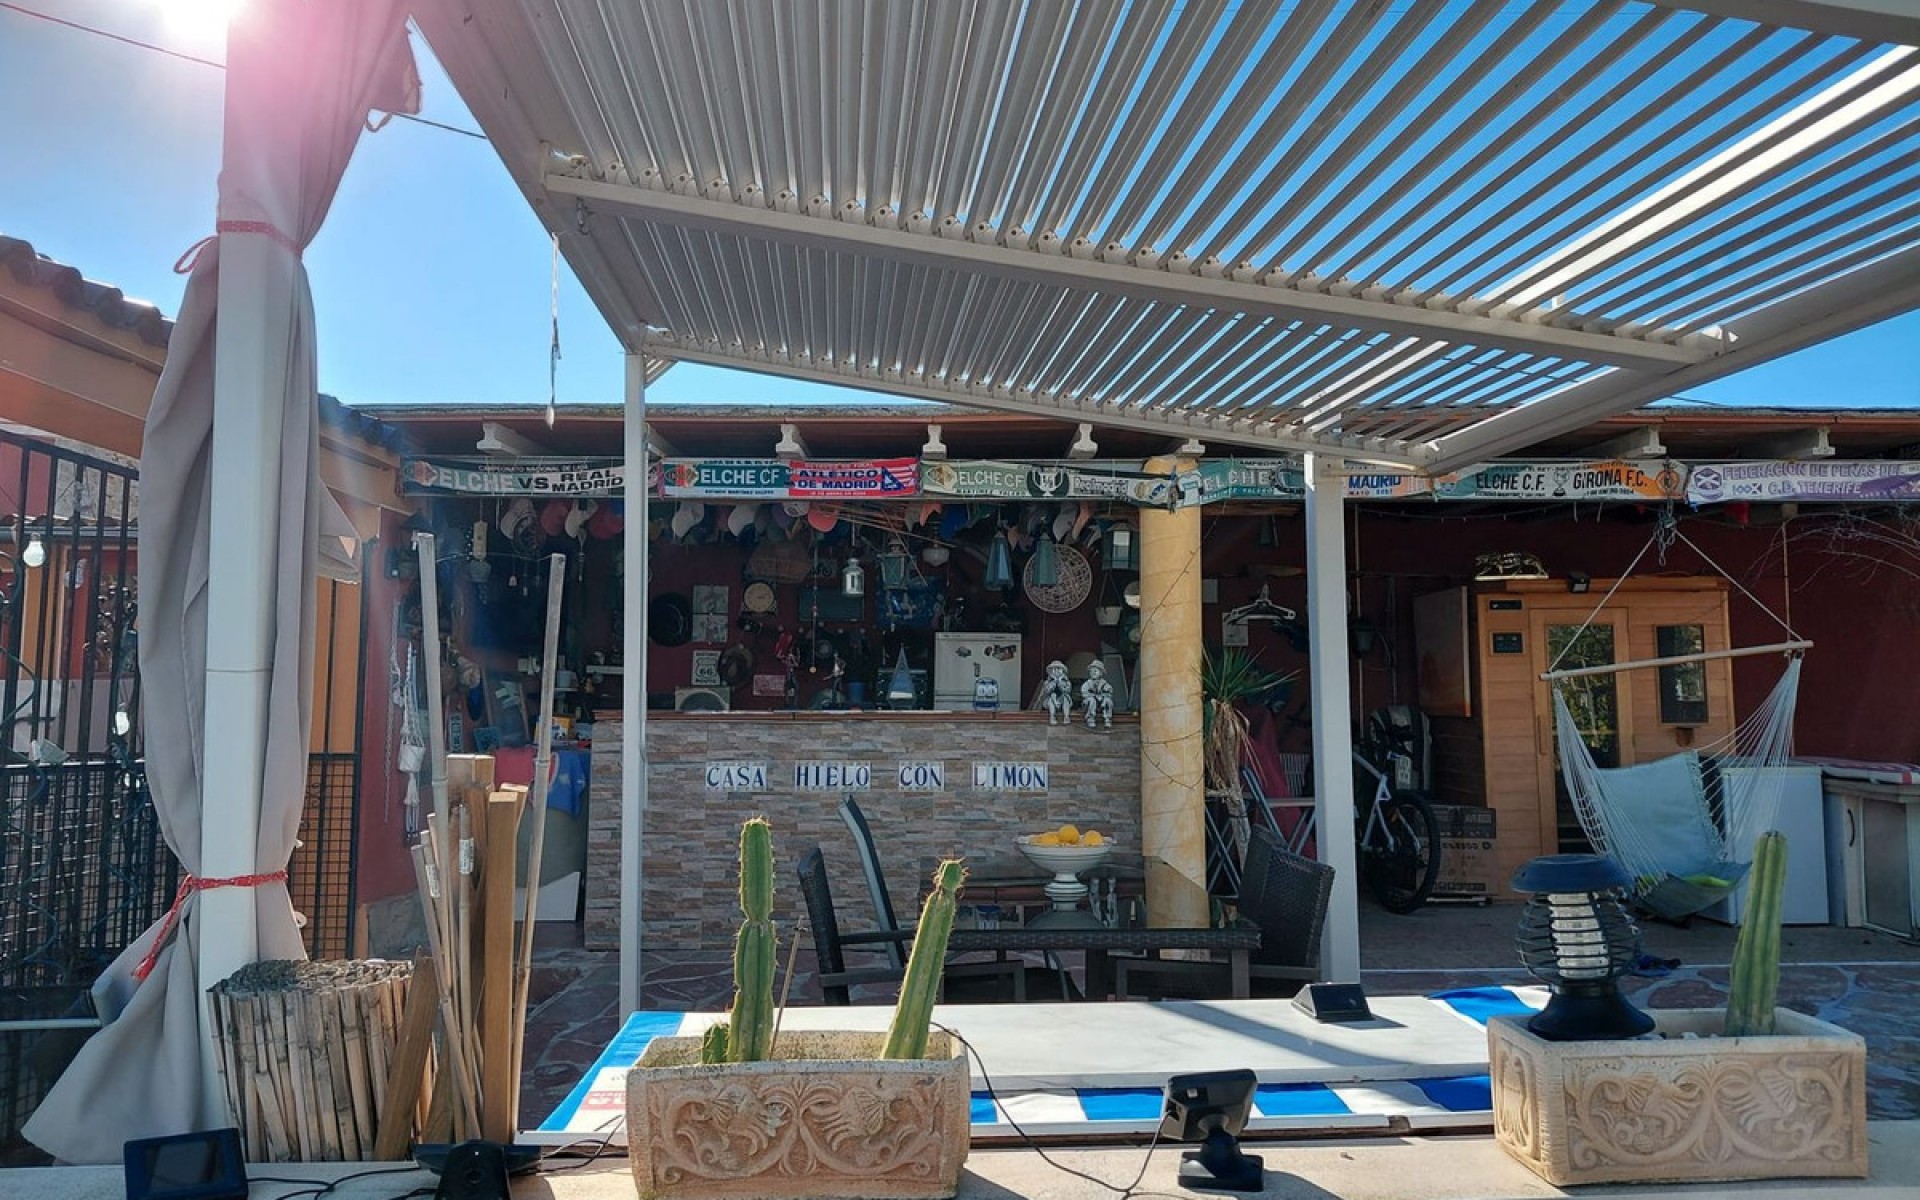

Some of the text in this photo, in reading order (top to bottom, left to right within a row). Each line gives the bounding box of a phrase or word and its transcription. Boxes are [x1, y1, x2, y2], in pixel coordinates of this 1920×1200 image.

[561, 468, 614, 482] REAL
[700, 468, 780, 485] ELCHE CF
[1809, 463, 1829, 477] DE
[439, 466, 549, 492] ELCHE VS
[552, 477, 624, 493] MADRID
[798, 480, 879, 489] DE MADRID
[958, 471, 1026, 489] ELCHE CF
[1203, 470, 1270, 491] ELCHE
[1475, 471, 1545, 490] ELCHE C.F.
[1572, 469, 1648, 490] GIRONA F.C.
[1797, 481, 1862, 494] TENERIFE
[706, 765, 1048, 790] CASA HIELO CON LIMON
